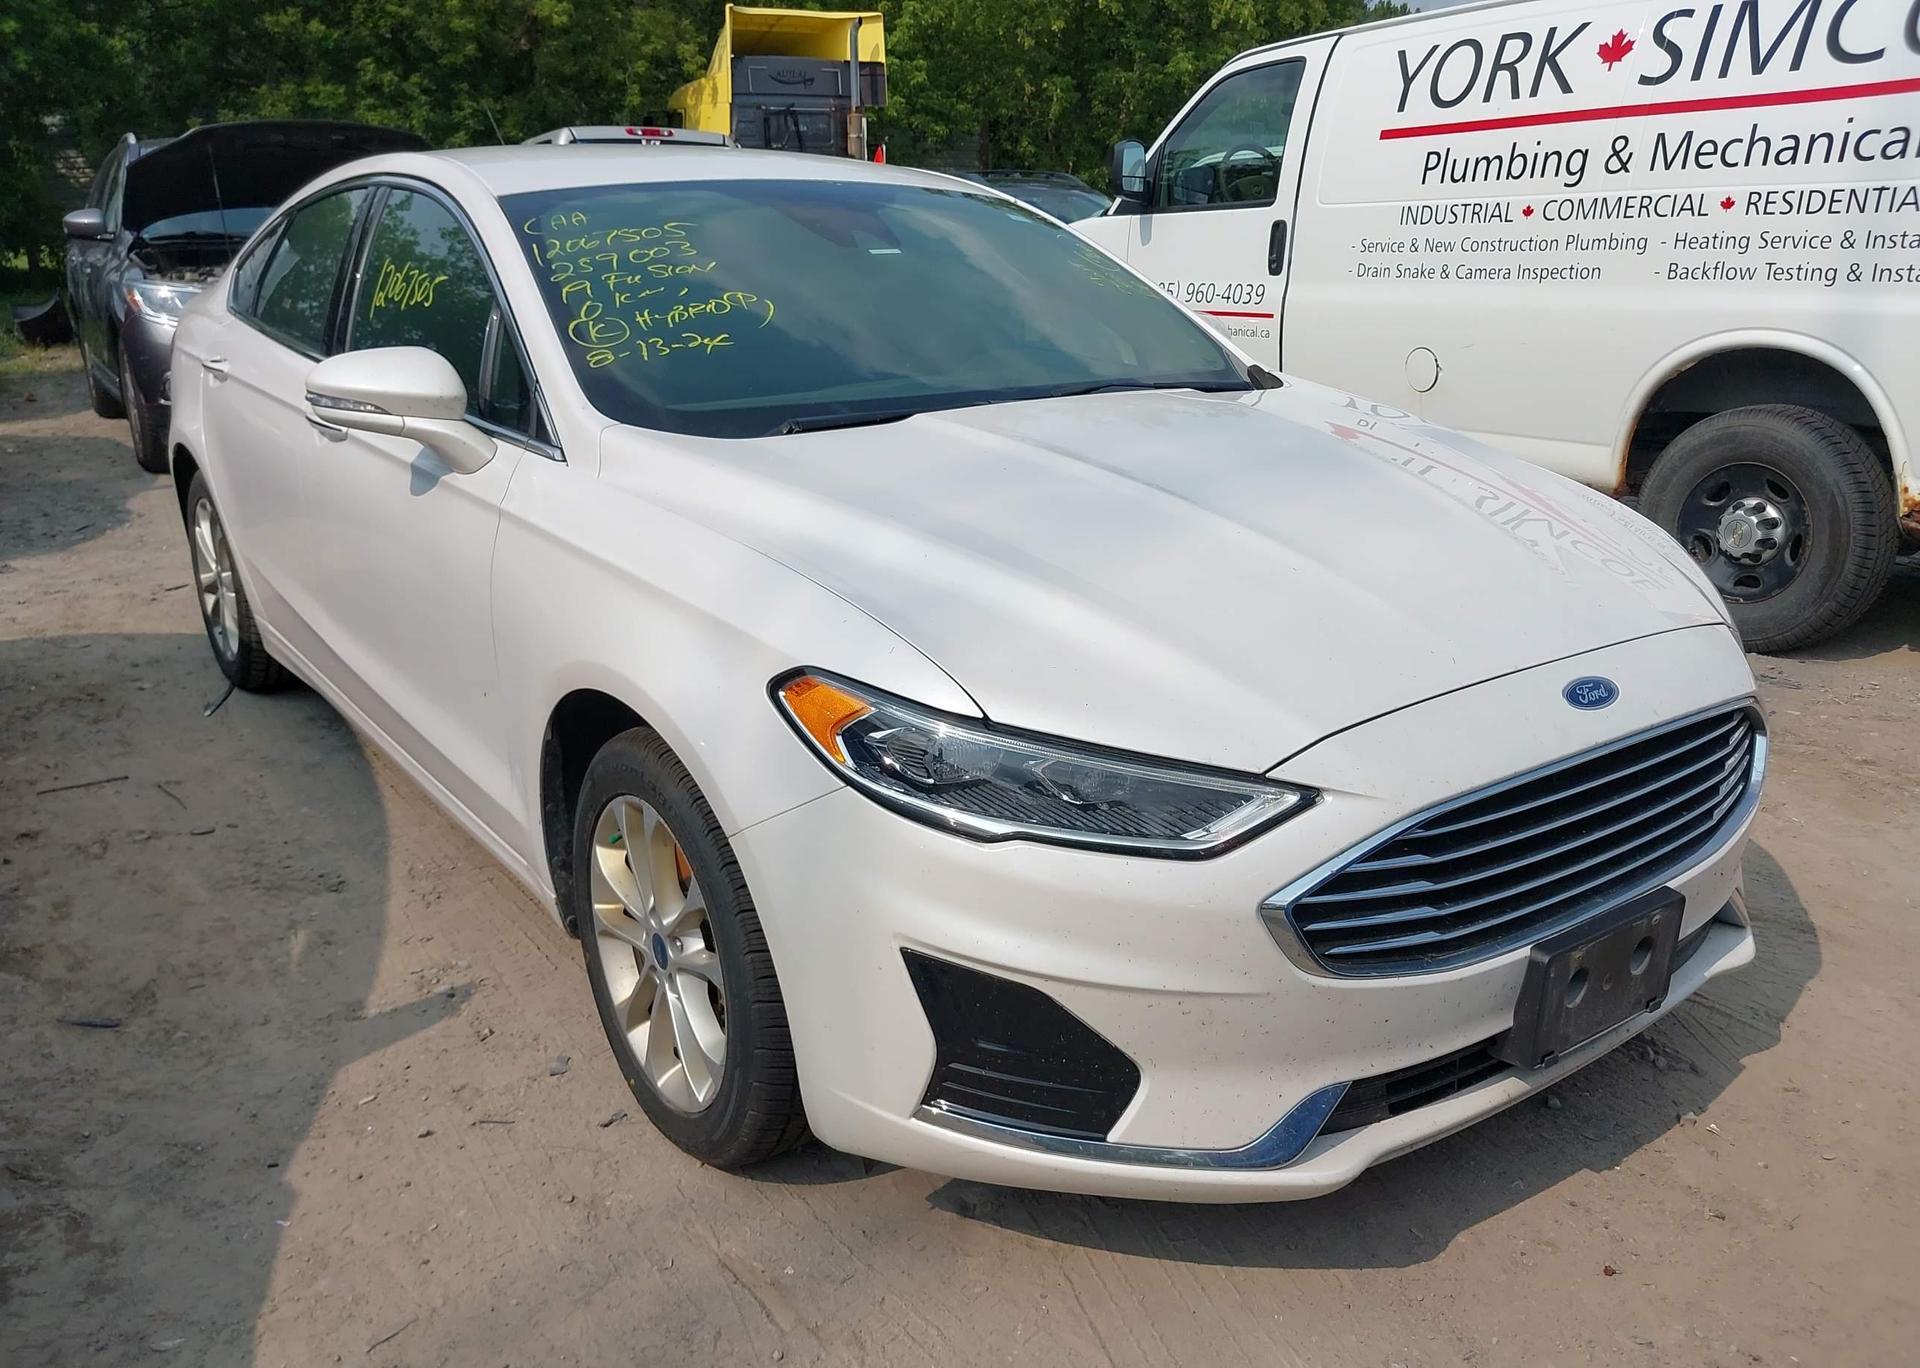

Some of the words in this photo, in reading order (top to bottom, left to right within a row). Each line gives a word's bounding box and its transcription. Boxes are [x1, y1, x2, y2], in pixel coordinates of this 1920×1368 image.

[1397, 22, 1592, 113] YORK
[1421, 140, 1589, 188] Plumbing
[1604, 135, 1634, 175] &
[1650, 117, 1920, 172] Mechanica
[1399, 202, 1514, 226] INDUSTRIAL
[1543, 193, 1710, 221] COMMERCIAL
[1360, 237, 1405, 253] Service
[1409, 237, 1419, 253] &
[1424, 237, 1456, 253] New
[1460, 235, 1559, 253] Construction
[1565, 232, 1649, 255] Plumbing
[1673, 231, 1750, 255] Heating
[1758, 230, 1832, 250] Service
[1840, 229, 1857, 250] &
[1357, 262, 1391, 279] Drain
[1395, 263, 1436, 280] Snake
[1439, 263, 1450, 280] &
[1455, 264, 1511, 280] Camera
[1517, 263, 1601, 284] Inspection
[1667, 261, 1757, 281] Backflow
[1764, 262, 1838, 287] Testing
[1846, 262, 1863, 282] &
[1184, 282, 1266, 305] 960-4039
[1575, 682, 1608, 704] Ford
